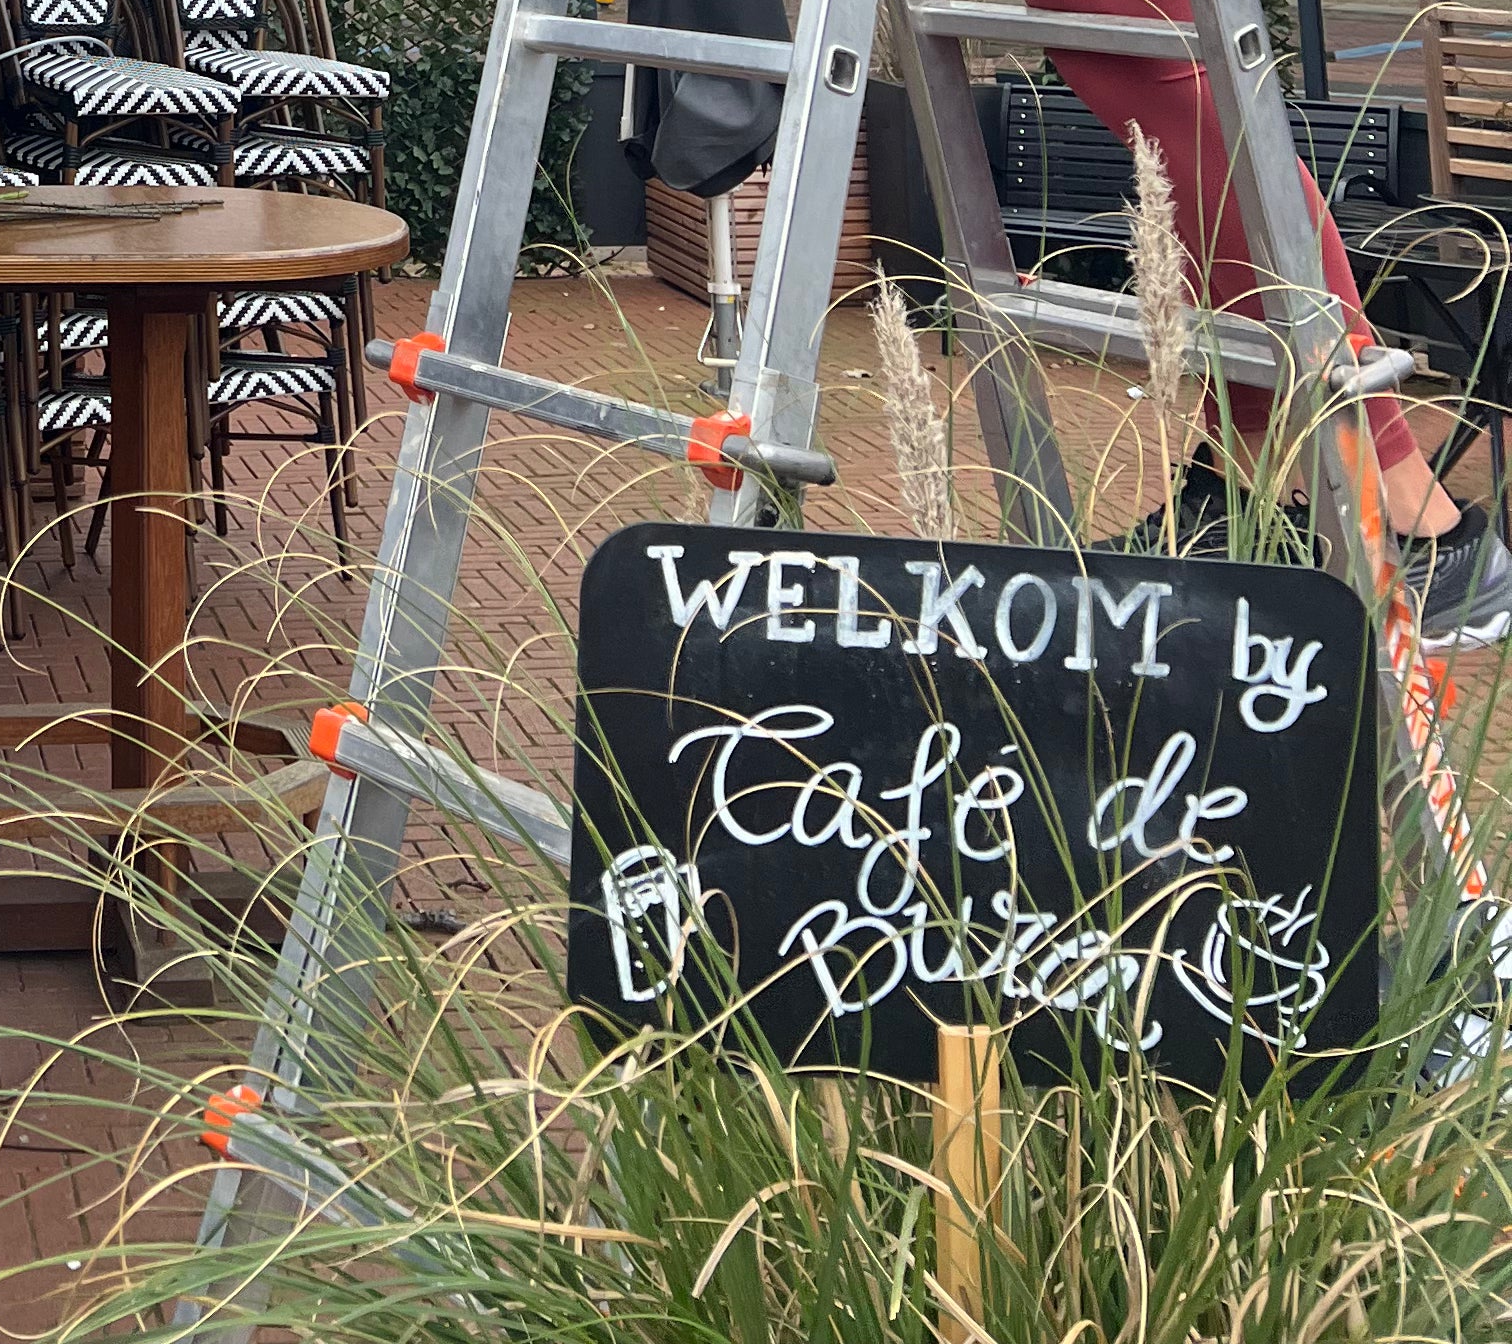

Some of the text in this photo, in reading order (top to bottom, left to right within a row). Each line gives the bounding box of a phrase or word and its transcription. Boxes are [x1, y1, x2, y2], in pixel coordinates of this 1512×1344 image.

[646, 544, 1328, 733] WELKOM by
[668, 703, 1248, 916] Café de
